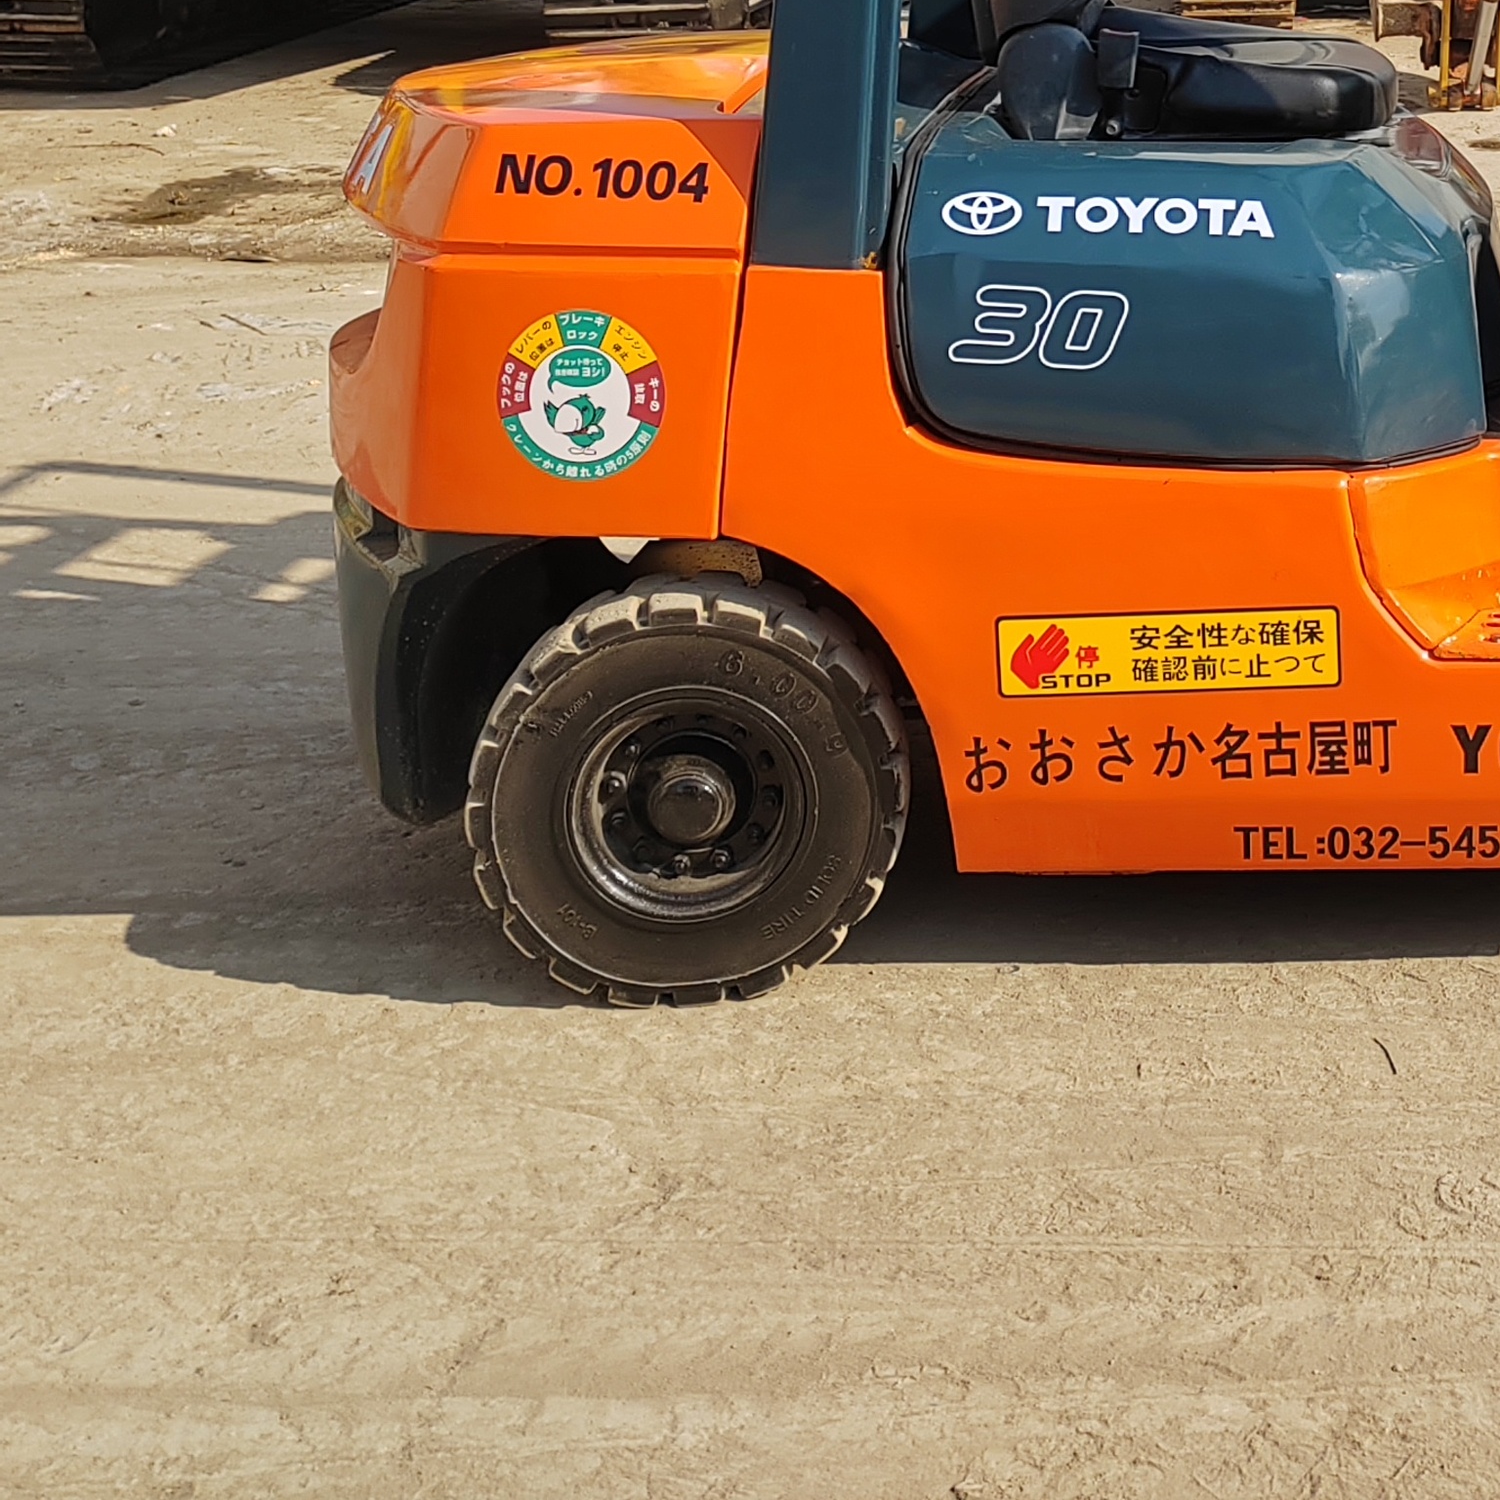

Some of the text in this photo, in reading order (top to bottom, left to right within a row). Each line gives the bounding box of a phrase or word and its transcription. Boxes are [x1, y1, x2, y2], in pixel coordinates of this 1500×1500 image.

[1037, 196, 1275, 238] TOYOTA
[948, 284, 1130, 370] 30
[1130, 619, 1325, 650] 安全性な確保
[1075, 645, 1099, 669] 停
[1041, 673, 1111, 690] STOP
